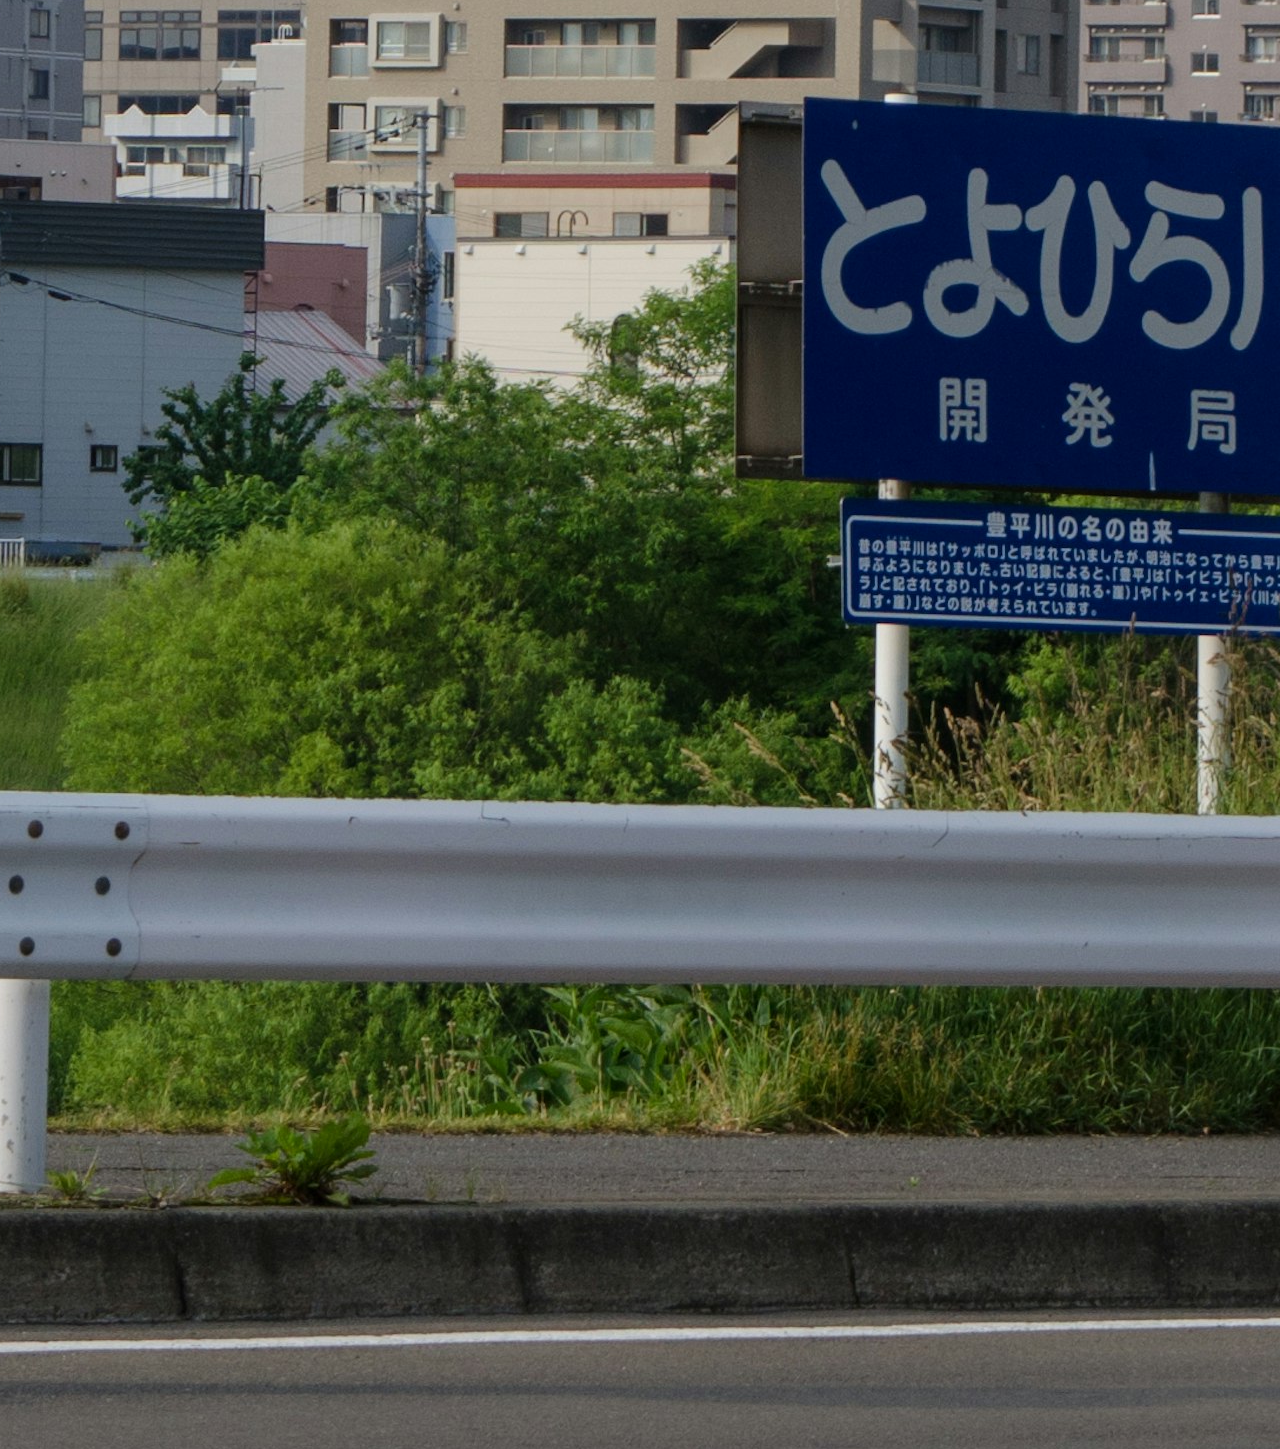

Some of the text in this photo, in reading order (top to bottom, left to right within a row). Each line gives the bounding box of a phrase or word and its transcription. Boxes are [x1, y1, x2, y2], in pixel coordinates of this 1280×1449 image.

[939, 378, 1237, 454] 開発局
[986, 512, 1173, 544] 豊平川の名の由来
